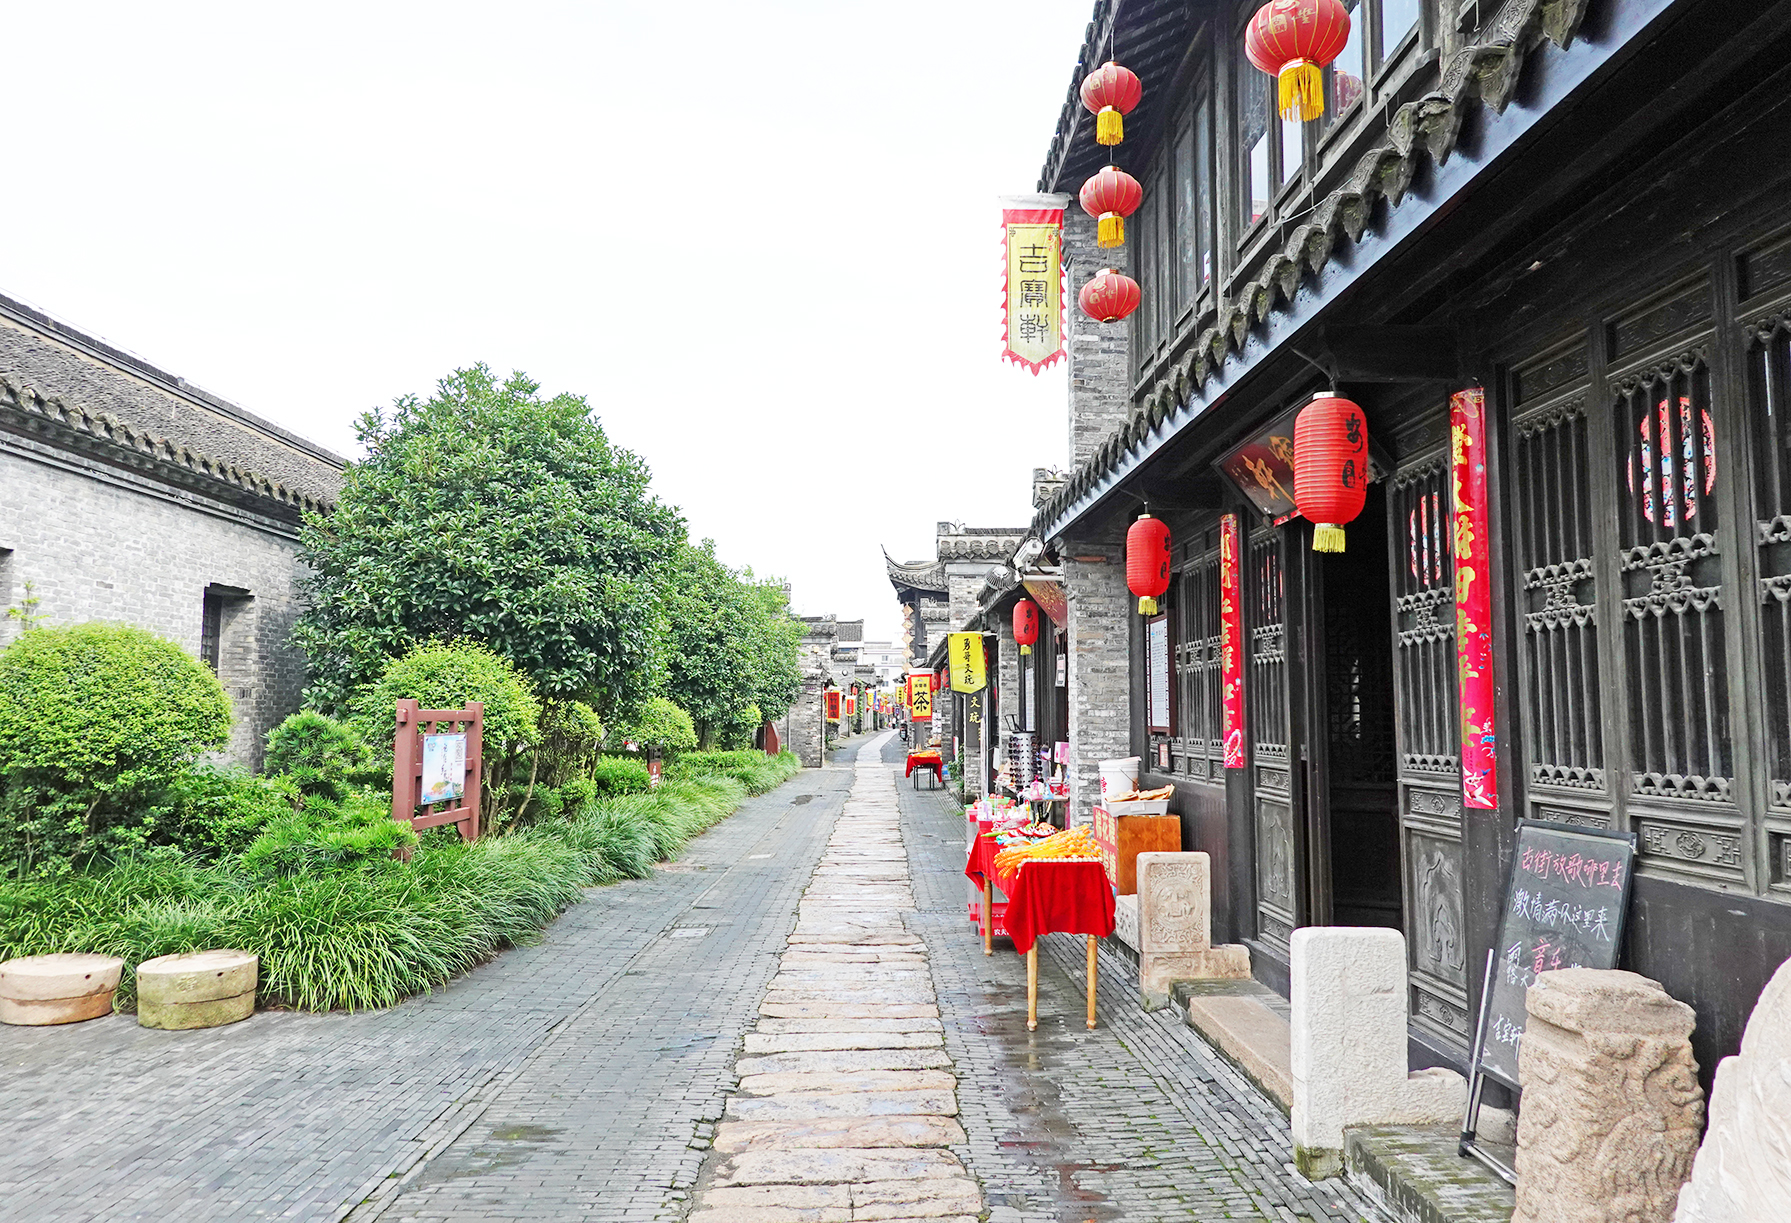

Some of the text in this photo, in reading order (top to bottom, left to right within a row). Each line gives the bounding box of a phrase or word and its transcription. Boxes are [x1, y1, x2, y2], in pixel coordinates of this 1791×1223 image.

[962, 637, 975, 686] 勇哥文玩
[913, 690, 930, 713] 茶
[969, 696, 981, 724] 文玩
[1521, 846, 1623, 891] 古街放歌哪里去
[1512, 888, 1610, 942] 激情满怀这里来
